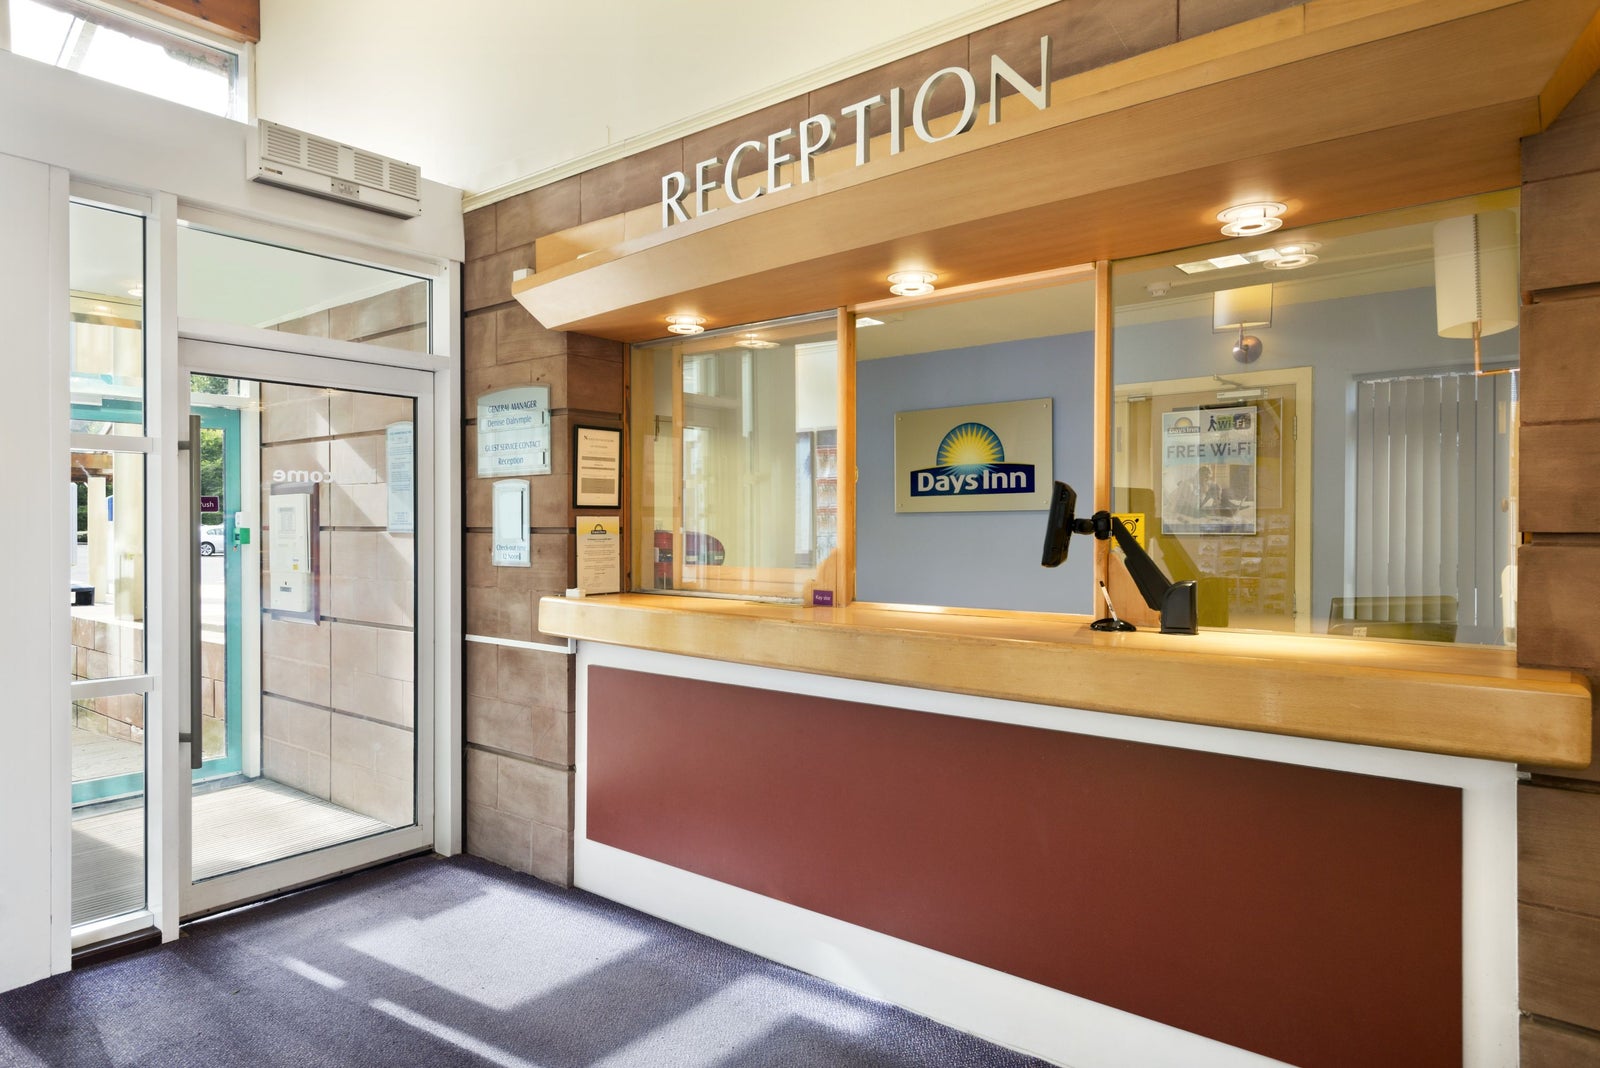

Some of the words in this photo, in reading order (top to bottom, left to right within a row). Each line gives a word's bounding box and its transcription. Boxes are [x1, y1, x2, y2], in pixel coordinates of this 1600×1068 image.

[661, 34, 1052, 228] RECEPTION
[487, 403, 510, 414] GENERAL
[511, 399, 538, 411] MANAGER
[487, 418, 505, 428] Denise
[505, 414, 532, 425] Dalrymple
[484, 443, 499, 452] GUEST
[499, 442, 518, 451] SERVICE
[518, 440, 541, 450] CONTACT
[1167, 443, 1206, 458] FREE
[1210, 441, 1251, 457] Wi-Fi
[498, 456, 524, 466] Reception
[917, 472, 978, 494] Days
[982, 469, 1027, 489] Inn
